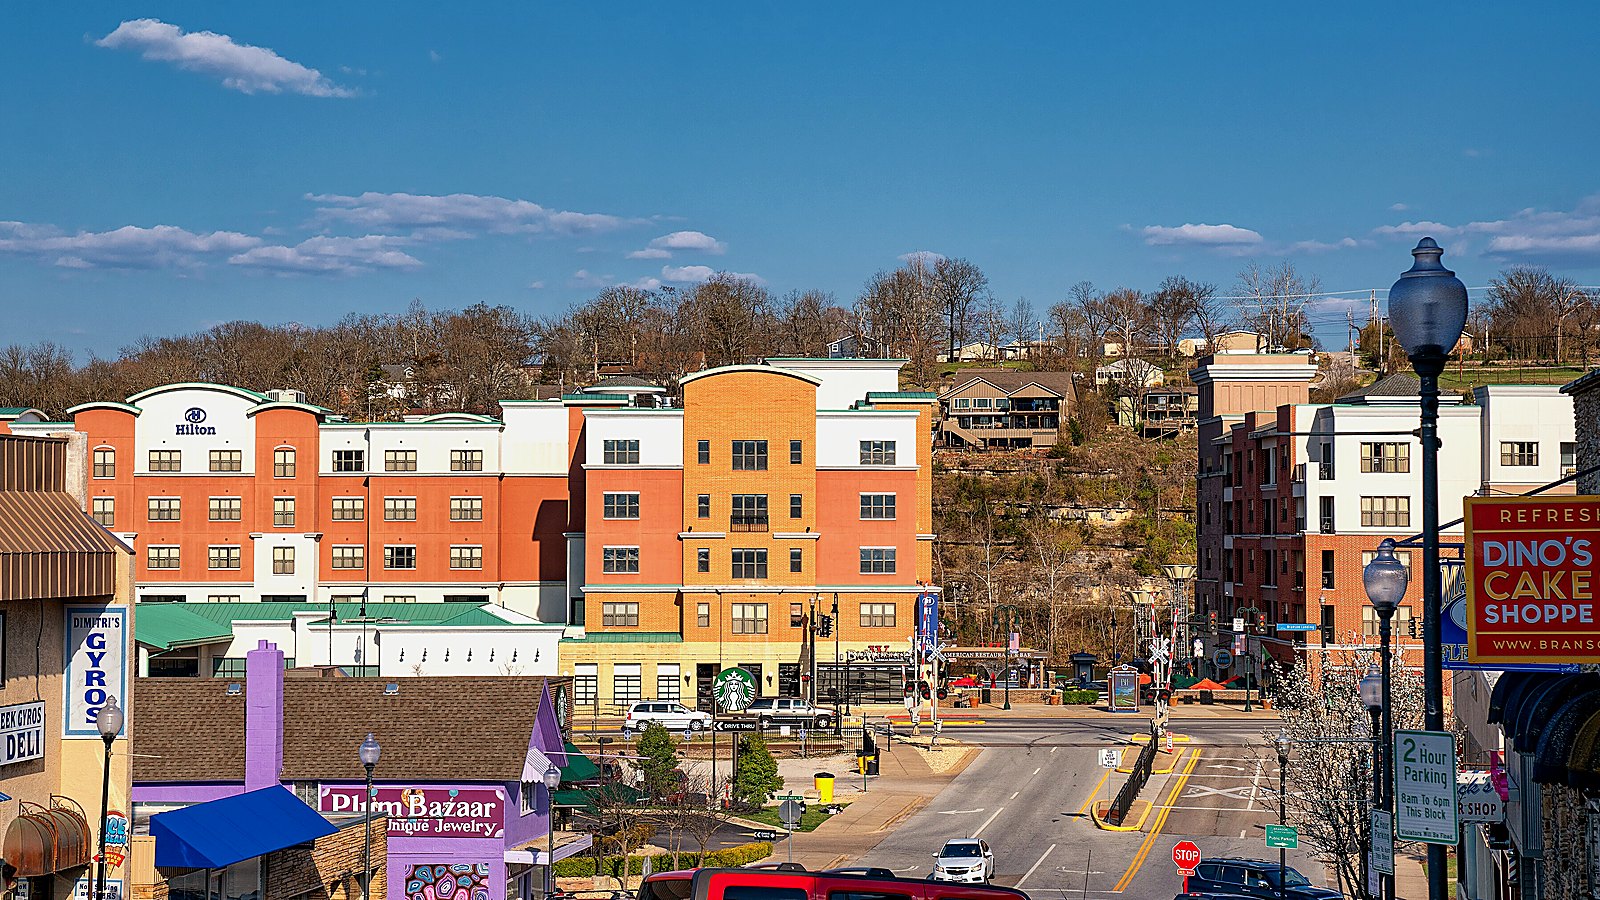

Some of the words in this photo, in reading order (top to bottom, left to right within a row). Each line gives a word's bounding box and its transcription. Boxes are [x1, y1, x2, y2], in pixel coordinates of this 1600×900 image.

[175, 423, 217, 436] Hilton
[1483, 536, 1593, 567] DINO'S
[1483, 570, 1593, 601] CAKE
[73, 617, 120, 629] DIMITRI'S
[1484, 603, 1594, 624] SHOPPE
[84, 632, 107, 724] GYROS
[17, 706, 42, 727] GYROS
[6, 729, 41, 761] DELI
[1402, 737, 1417, 763] 2
[1420, 748, 1447, 766] Hour
[1404, 765, 1447, 789] Parking
[408, 794, 497, 819] Bazaar
[1401, 792, 1418, 804] 8am
[1421, 794, 1430, 806] To
[1433, 795, 1450, 808] 6pm
[1467, 802, 1497, 816] SHOP
[1405, 805, 1422, 818] This
[1425, 807, 1446, 820] Block
[435, 818, 498, 837] Jewelry
[1175, 849, 1199, 862] STOP
